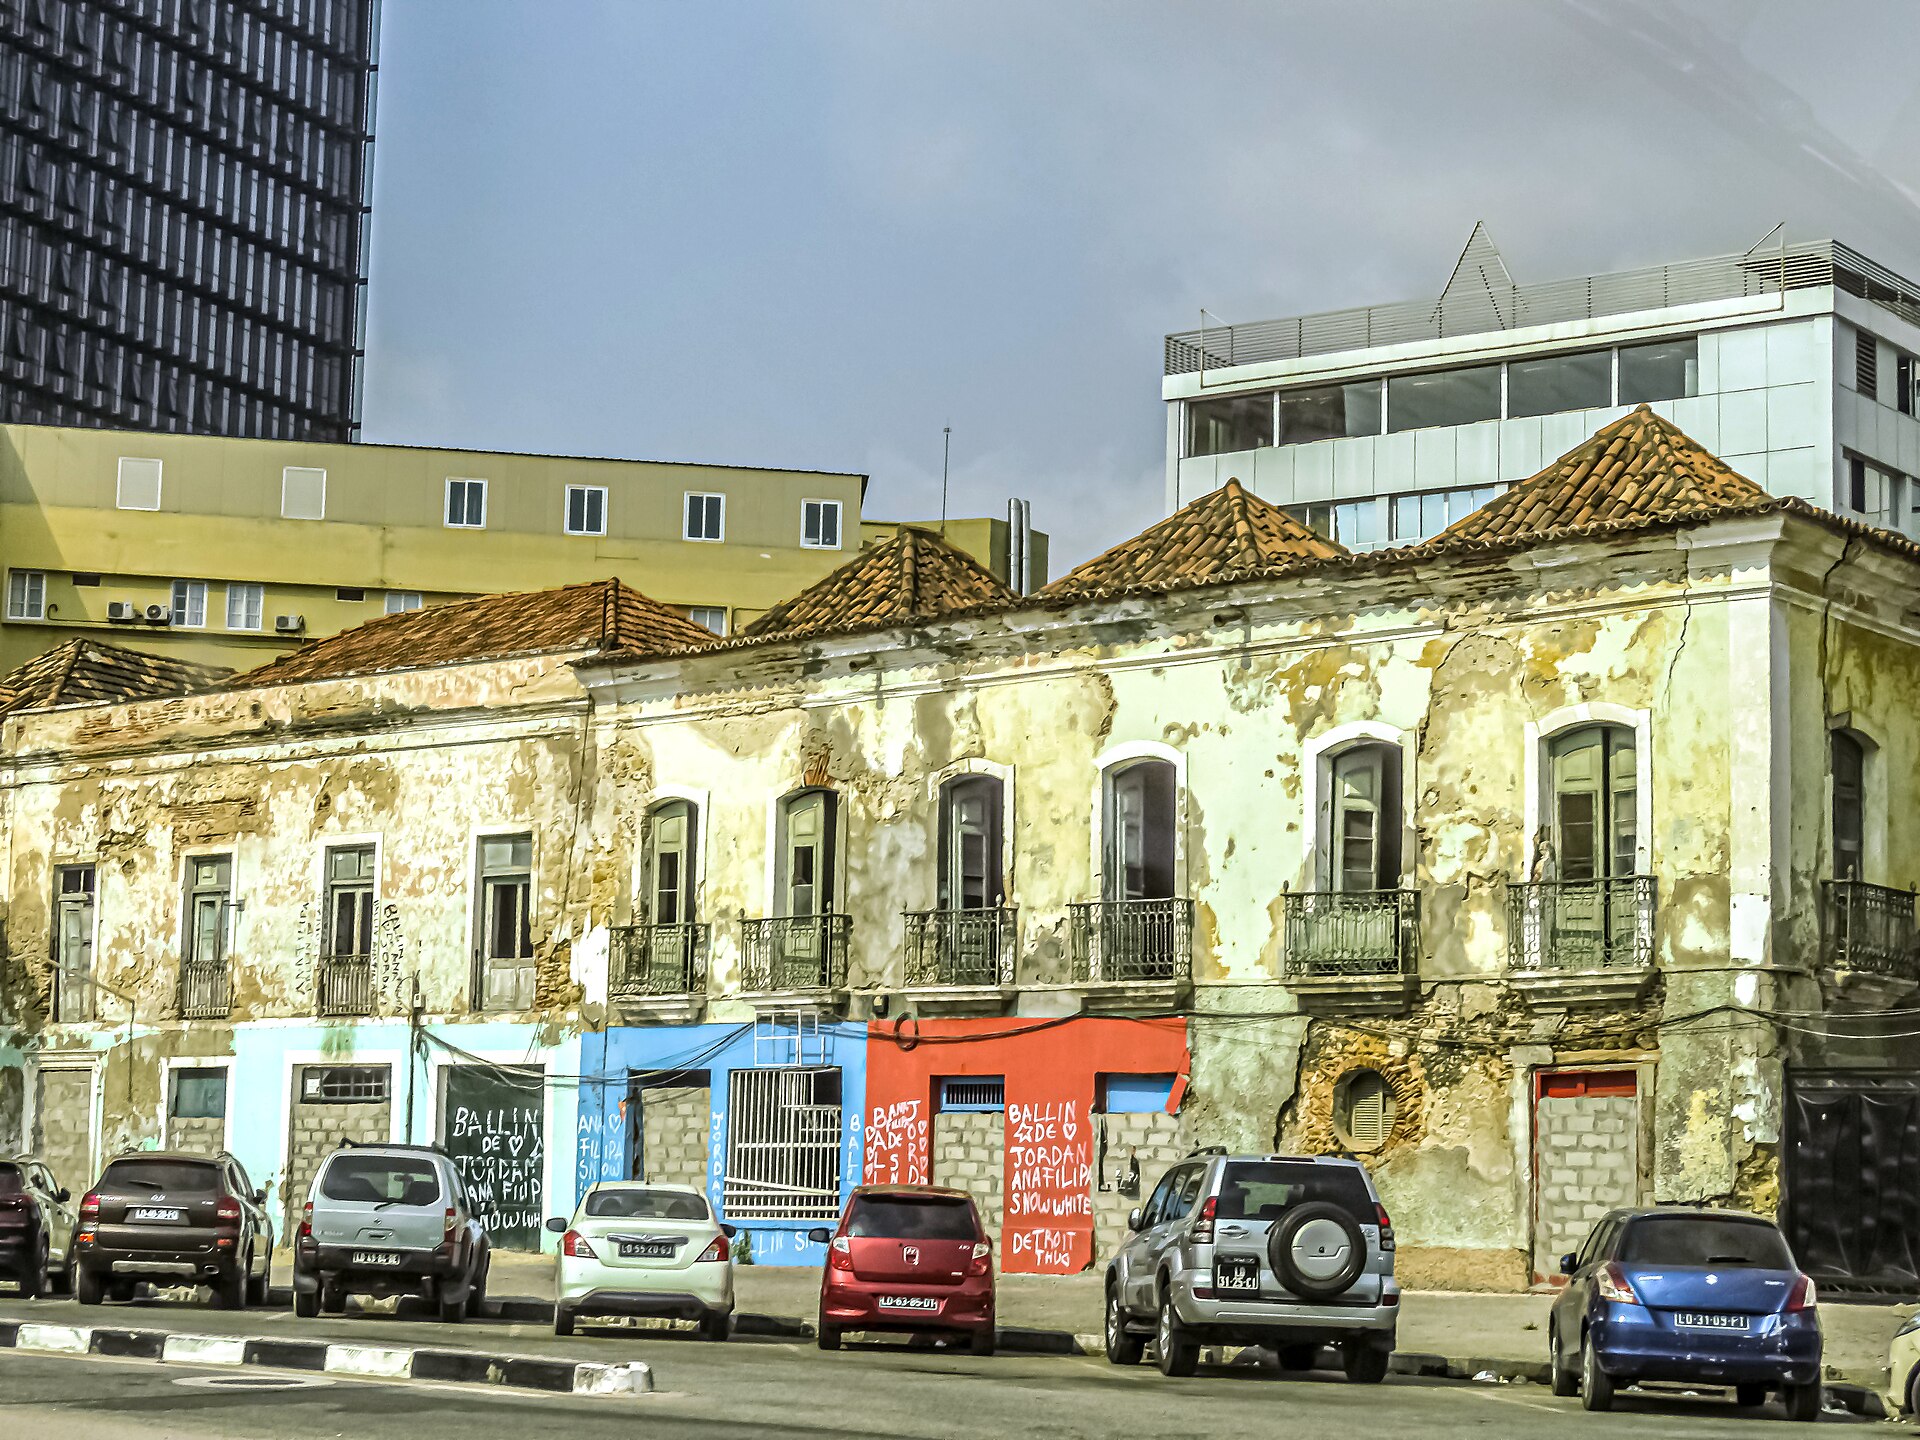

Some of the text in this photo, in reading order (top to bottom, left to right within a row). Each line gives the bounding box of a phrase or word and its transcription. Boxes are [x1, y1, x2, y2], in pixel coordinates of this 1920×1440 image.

[452, 1106, 539, 1139] BALLIN
[1008, 1100, 1076, 1124] BALLIN
[482, 1135, 500, 1154] DE
[1034, 1123, 1057, 1143] DE
[1009, 1141, 1087, 1168] JORDAN
[455, 1155, 537, 1184] JORDAN
[502, 1177, 542, 1204] FILIP
[1012, 1229, 1077, 1254] DETROIT
[1035, 1250, 1070, 1268] THUG
